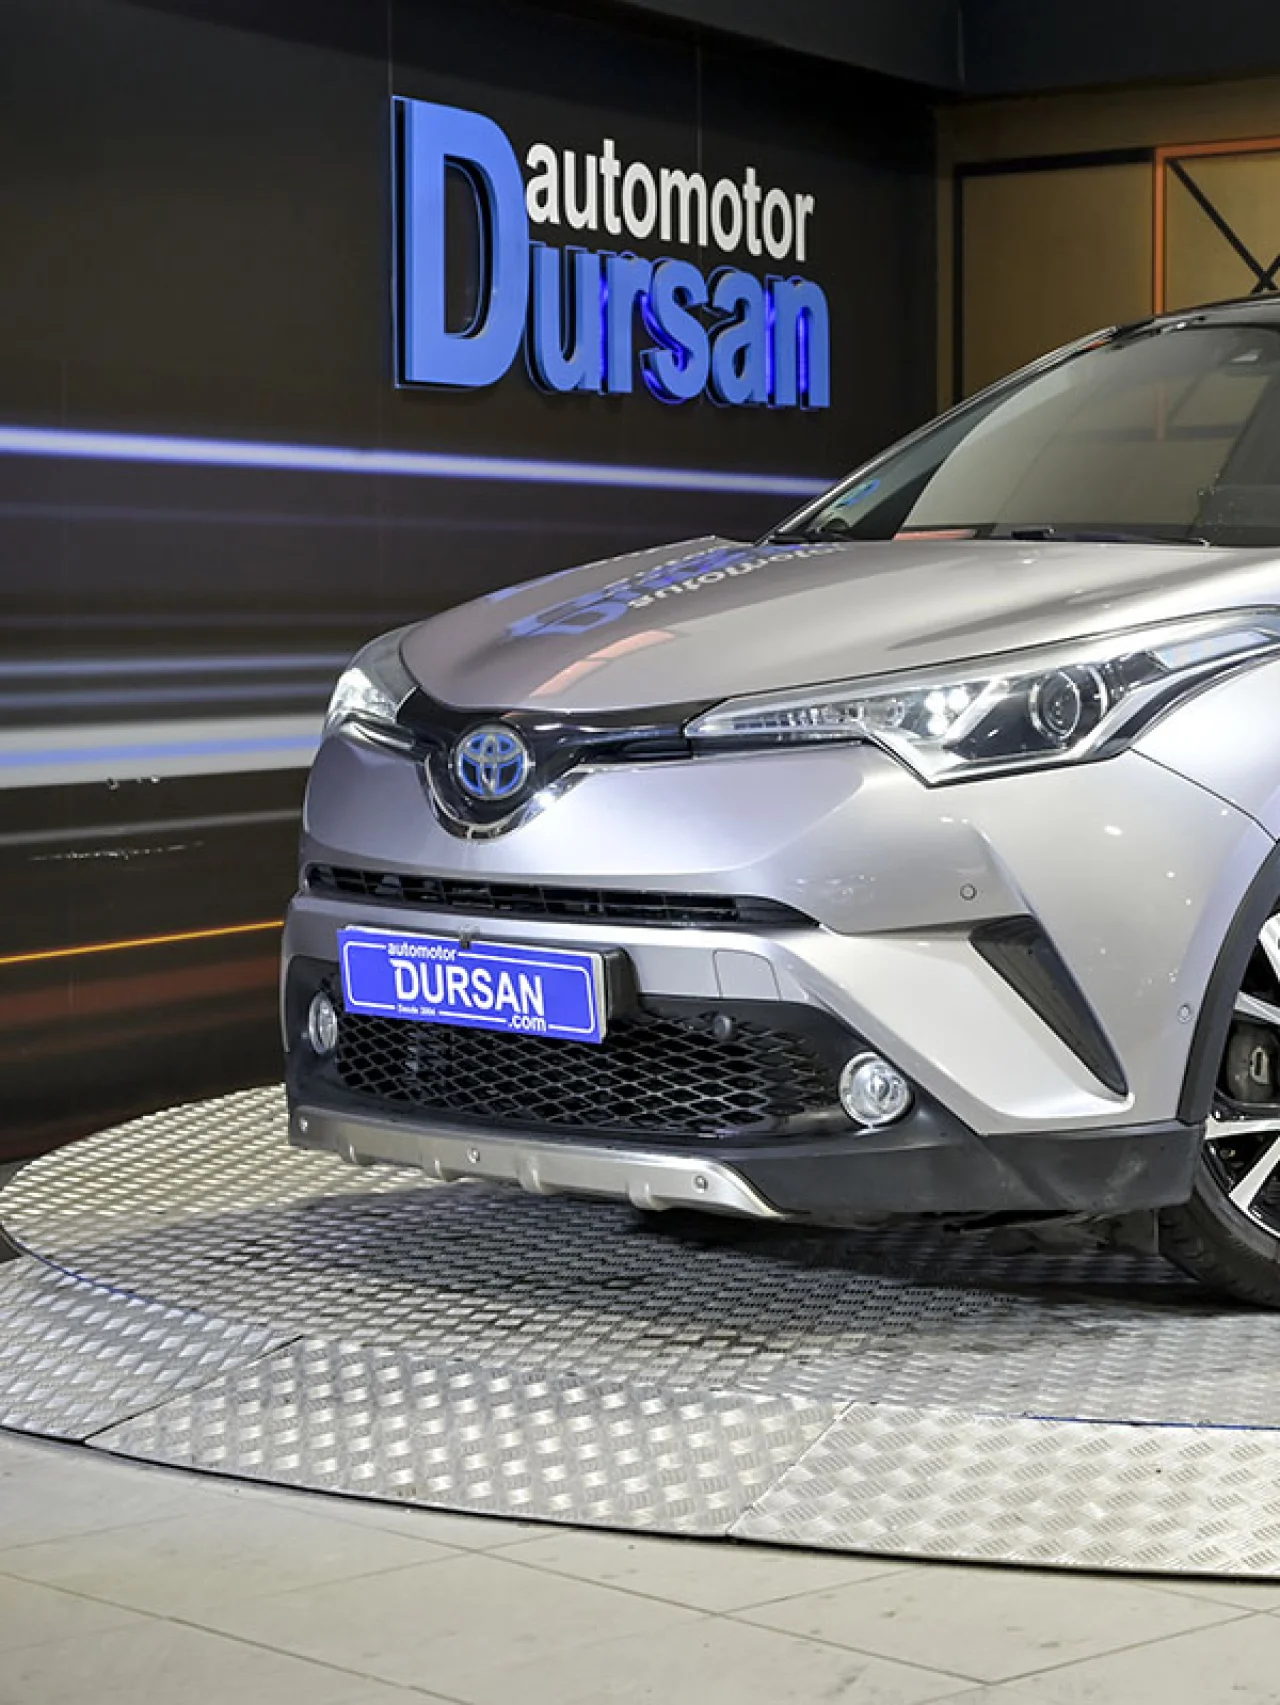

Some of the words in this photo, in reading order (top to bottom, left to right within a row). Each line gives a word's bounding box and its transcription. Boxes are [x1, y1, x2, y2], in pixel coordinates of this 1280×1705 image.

[526, 138, 815, 261] automotor
[392, 95, 830, 411] Dursan
[387, 942, 457, 961] automotor
[389, 959, 545, 1016] DURSAN
[508, 1015, 547, 1032] .com
